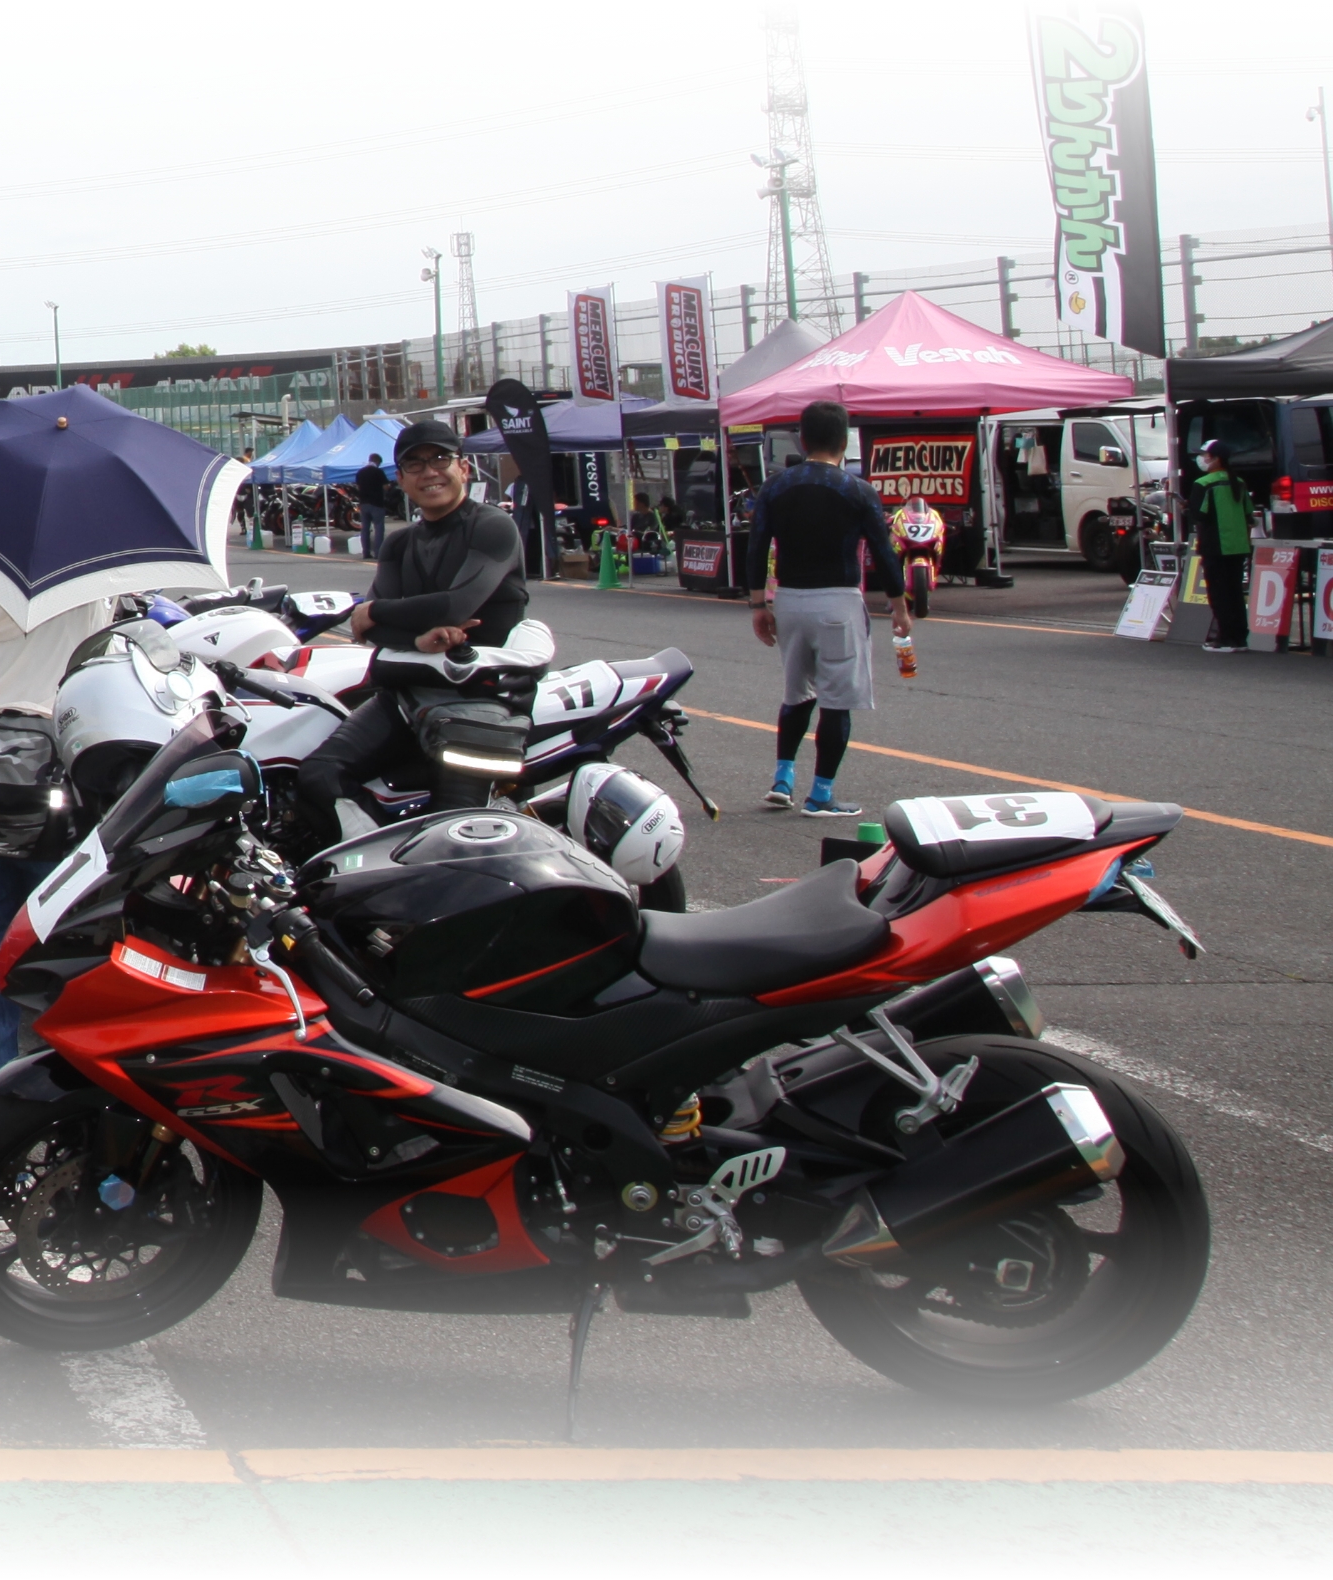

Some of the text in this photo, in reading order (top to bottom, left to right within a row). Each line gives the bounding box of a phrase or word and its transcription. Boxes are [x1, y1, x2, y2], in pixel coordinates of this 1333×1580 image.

[589, 301, 611, 396] MERCURY
[682, 292, 705, 395] MERCURY
[884, 342, 1022, 367] Vesrah
[501, 416, 532, 430] SAINT
[872, 441, 971, 475] MERCURY
[871, 475, 964, 498] PRODUCTS
[907, 524, 933, 539] 97
[1256, 570, 1284, 617] D
[547, 678, 595, 711] 17
[643, 809, 665, 833] SHOEI
[943, 795, 1049, 831] 31
[176, 1097, 265, 1117] GSX
